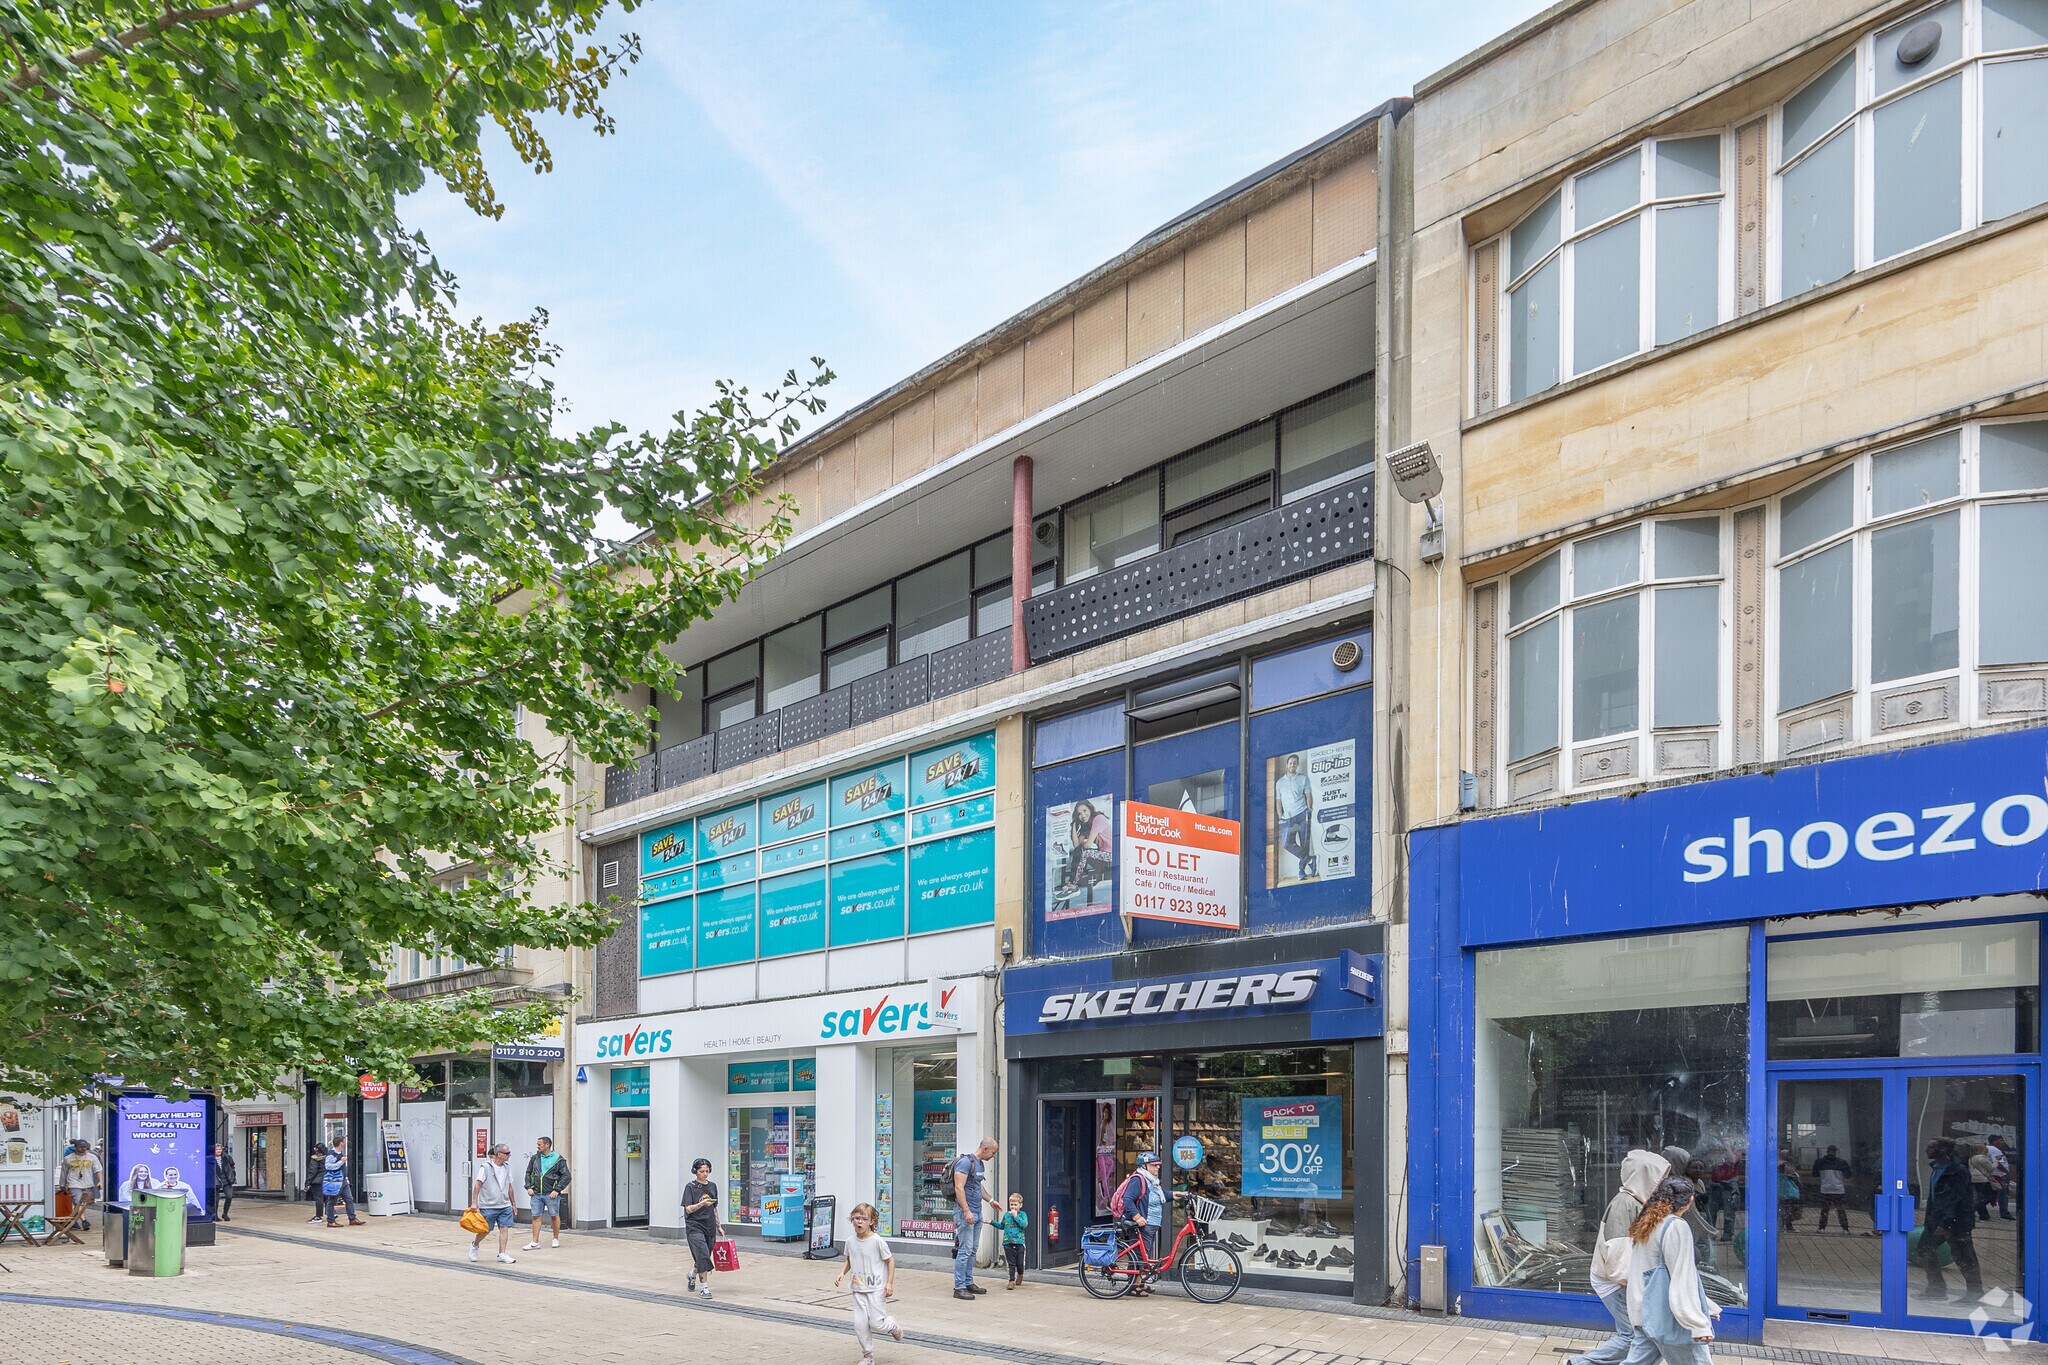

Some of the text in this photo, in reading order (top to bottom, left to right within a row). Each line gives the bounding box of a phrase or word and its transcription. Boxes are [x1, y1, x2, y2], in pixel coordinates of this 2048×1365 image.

[1311, 745, 1354, 758] SKECHERS
[928, 752, 960, 780] SAVE
[947, 759, 977, 787] 24/7
[846, 777, 875, 803] SAVE
[863, 784, 889, 809] 24/7
[1322, 794, 1338, 802] SLIP
[774, 798, 800, 822] SAVE
[789, 805, 813, 829] 24/7
[709, 817, 734, 840] SAVE
[1135, 811, 1233, 836] Hartnell htc.uk.com
[723, 823, 745, 846] 24/7
[652, 834, 674, 855] SAVE
[664, 841, 685, 861] 24/7
[1135, 846, 1201, 871] TO LET
[940, 874, 962, 882] always
[964, 870, 980, 879] open
[981, 866, 989, 874] at
[1135, 867, 1156, 877] Retail
[1163, 871, 1204, 884] Restaurant
[857, 890, 878, 899] always
[878, 887, 893, 895] open
[921, 878, 984, 900] savers.co.uk
[1135, 879, 1152, 888] Café
[1159, 882, 1182, 892] Office
[1188, 886, 1216, 896] Medical
[766, 908, 775, 916] We
[784, 904, 802, 913] always
[802, 902, 816, 910] open
[840, 895, 896, 915] savers.co.uk
[1135, 894, 1227, 918] 0117 923 9234
[769, 909, 818, 928] savers.co.uk
[705, 922, 749, 939] savers.co.uk
[648, 934, 688, 950] savers.co.uk
[1350, 966, 1374, 983] SKECHERS
[1039, 969, 1322, 1023] SKECHERS
[935, 1010, 958, 1021] savers
[596, 1023, 673, 1058] savers
[703, 1034, 781, 1049] HEALTH HOME BEAUTY
[518, 1048, 535, 1056] 910
[537, 1049, 561, 1057] 2200
[1263, 1104, 1315, 1118] BACK TO
[1274, 1118, 1318, 1126] SCHOOL
[1264, 1127, 1306, 1137] SALE!
[1259, 1143, 1323, 1174] 30%
[1303, 1165, 1323, 1175] OFF
[765, 1200, 779, 1209] SAVE
[912, 1221, 930, 1229] BEFORE
[932, 1222, 942, 1230] YOU
[943, 1222, 953, 1230] FLY!
[927, 1232, 953, 1240] FRAGRANCE
